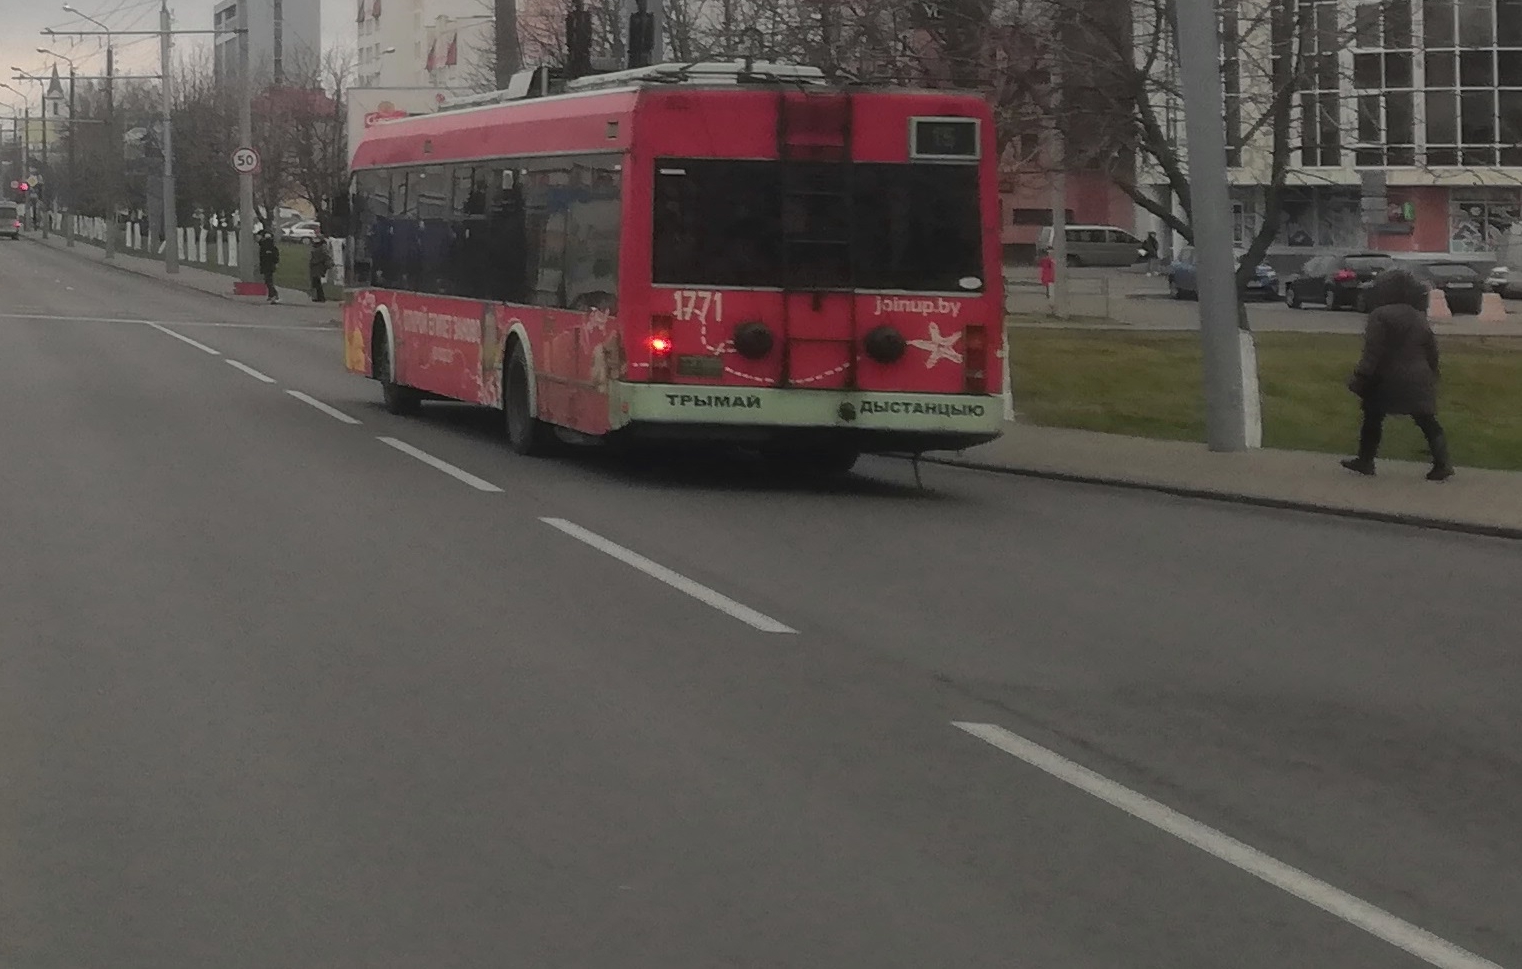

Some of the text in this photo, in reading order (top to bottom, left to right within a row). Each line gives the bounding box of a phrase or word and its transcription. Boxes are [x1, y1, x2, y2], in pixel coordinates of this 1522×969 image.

[237, 154, 254, 167] 50
[673, 290, 723, 322] 1771
[874, 295, 961, 316] joinup.by
[665, 393, 986, 418] ТРЫМАЙ ДЫСТАНЦЫЮ
